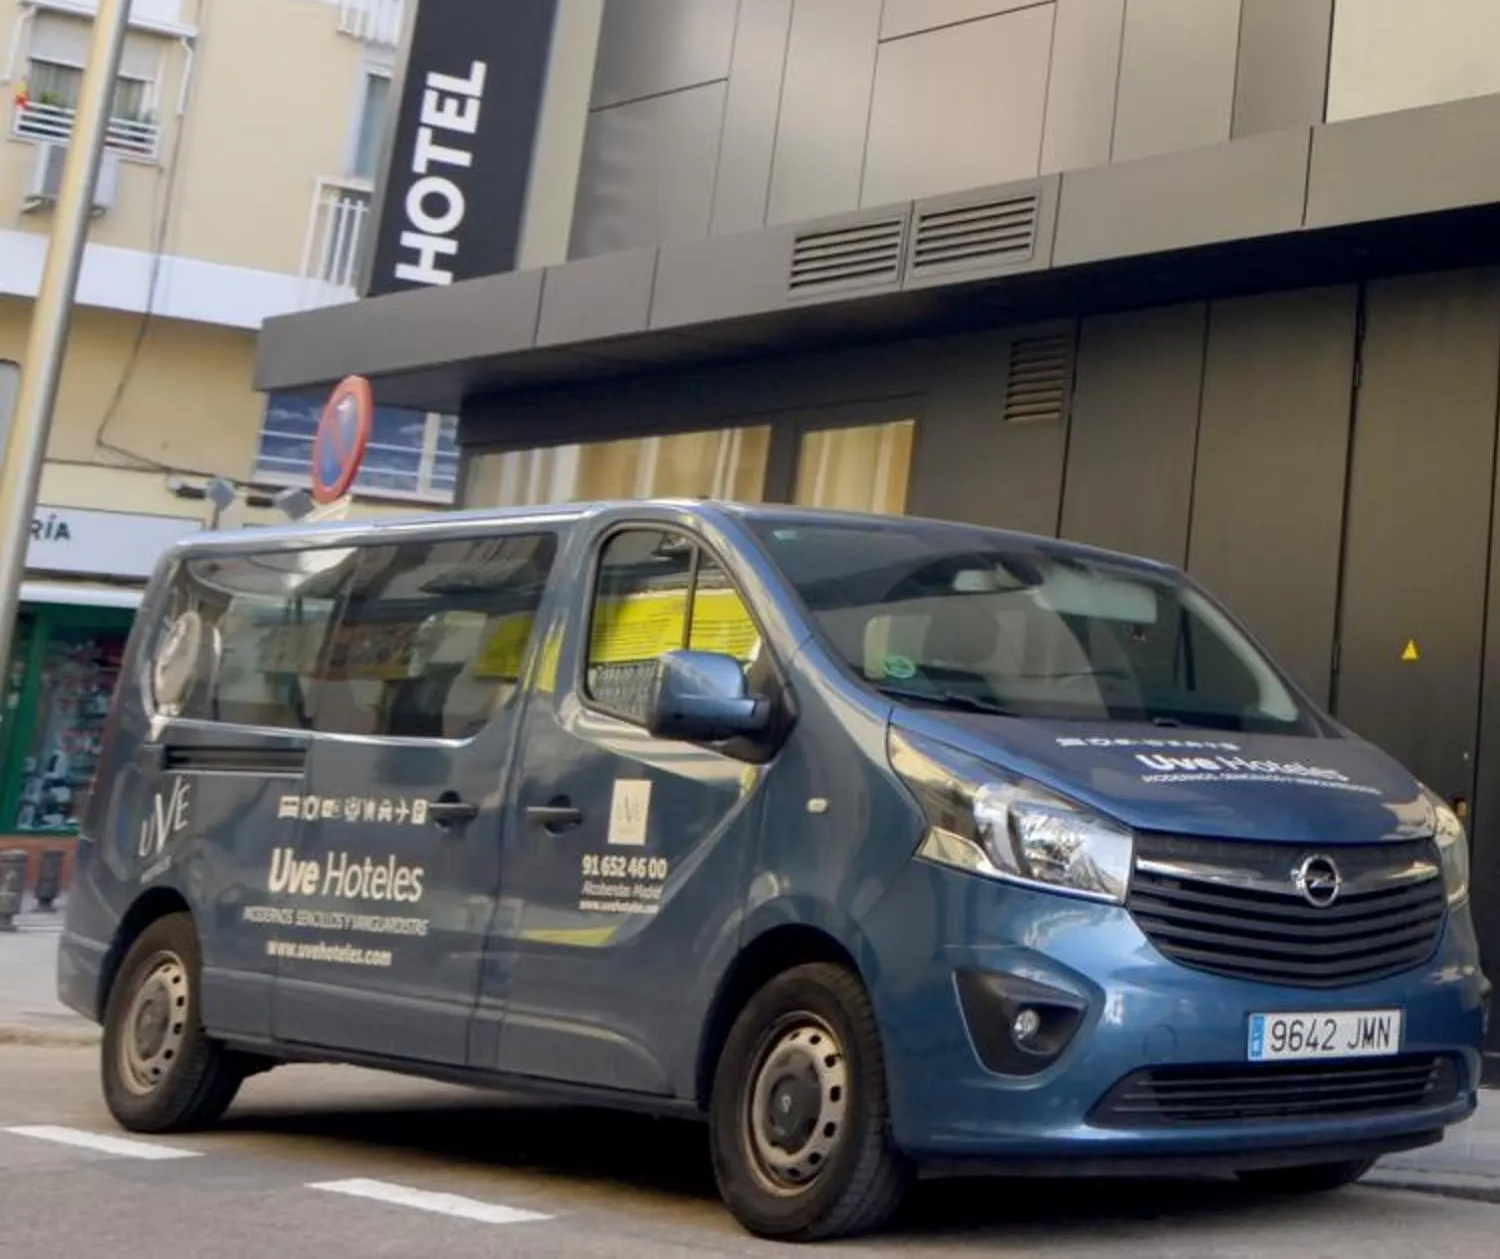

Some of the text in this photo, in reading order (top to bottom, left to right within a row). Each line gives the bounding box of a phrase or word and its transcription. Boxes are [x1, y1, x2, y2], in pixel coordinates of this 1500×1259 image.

[395, 60, 487, 285] HOTEL
[1134, 754, 1220, 770] Uve
[139, 775, 191, 857] UVE
[268, 847, 425, 903] Uve Hoteles
[582, 853, 600, 876] 91
[1270, 1018, 1338, 1053] 9642
[1347, 1016, 1392, 1049] JMN
